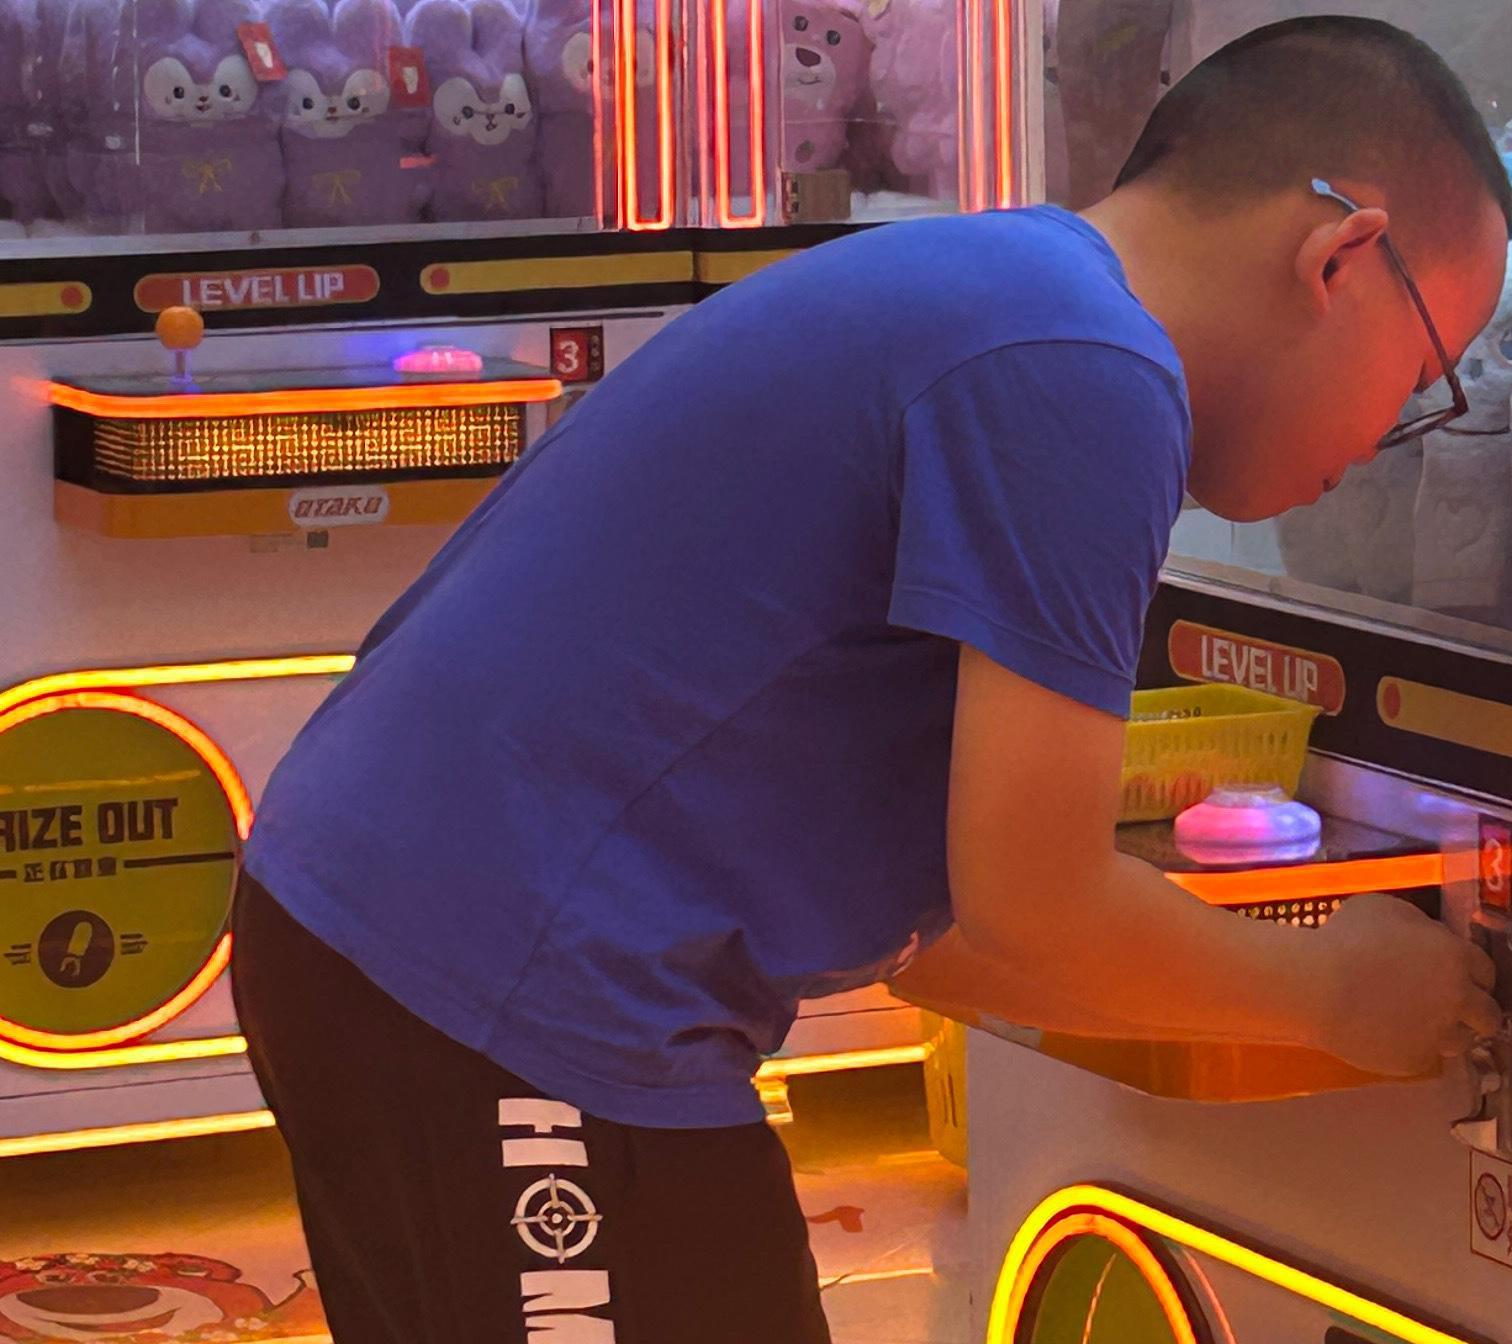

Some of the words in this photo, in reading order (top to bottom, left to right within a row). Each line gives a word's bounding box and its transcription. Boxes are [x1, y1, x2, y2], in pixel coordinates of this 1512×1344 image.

[182, 273, 291, 309] LEVEL
[297, 270, 346, 302] UP
[556, 339, 581, 374] 3
[1200, 634, 1274, 690] LEVEL
[1281, 662, 1319, 701] UP
[0, 804, 84, 854] RIZE
[97, 796, 180, 844] OUT
[1483, 837, 1504, 894] 3
